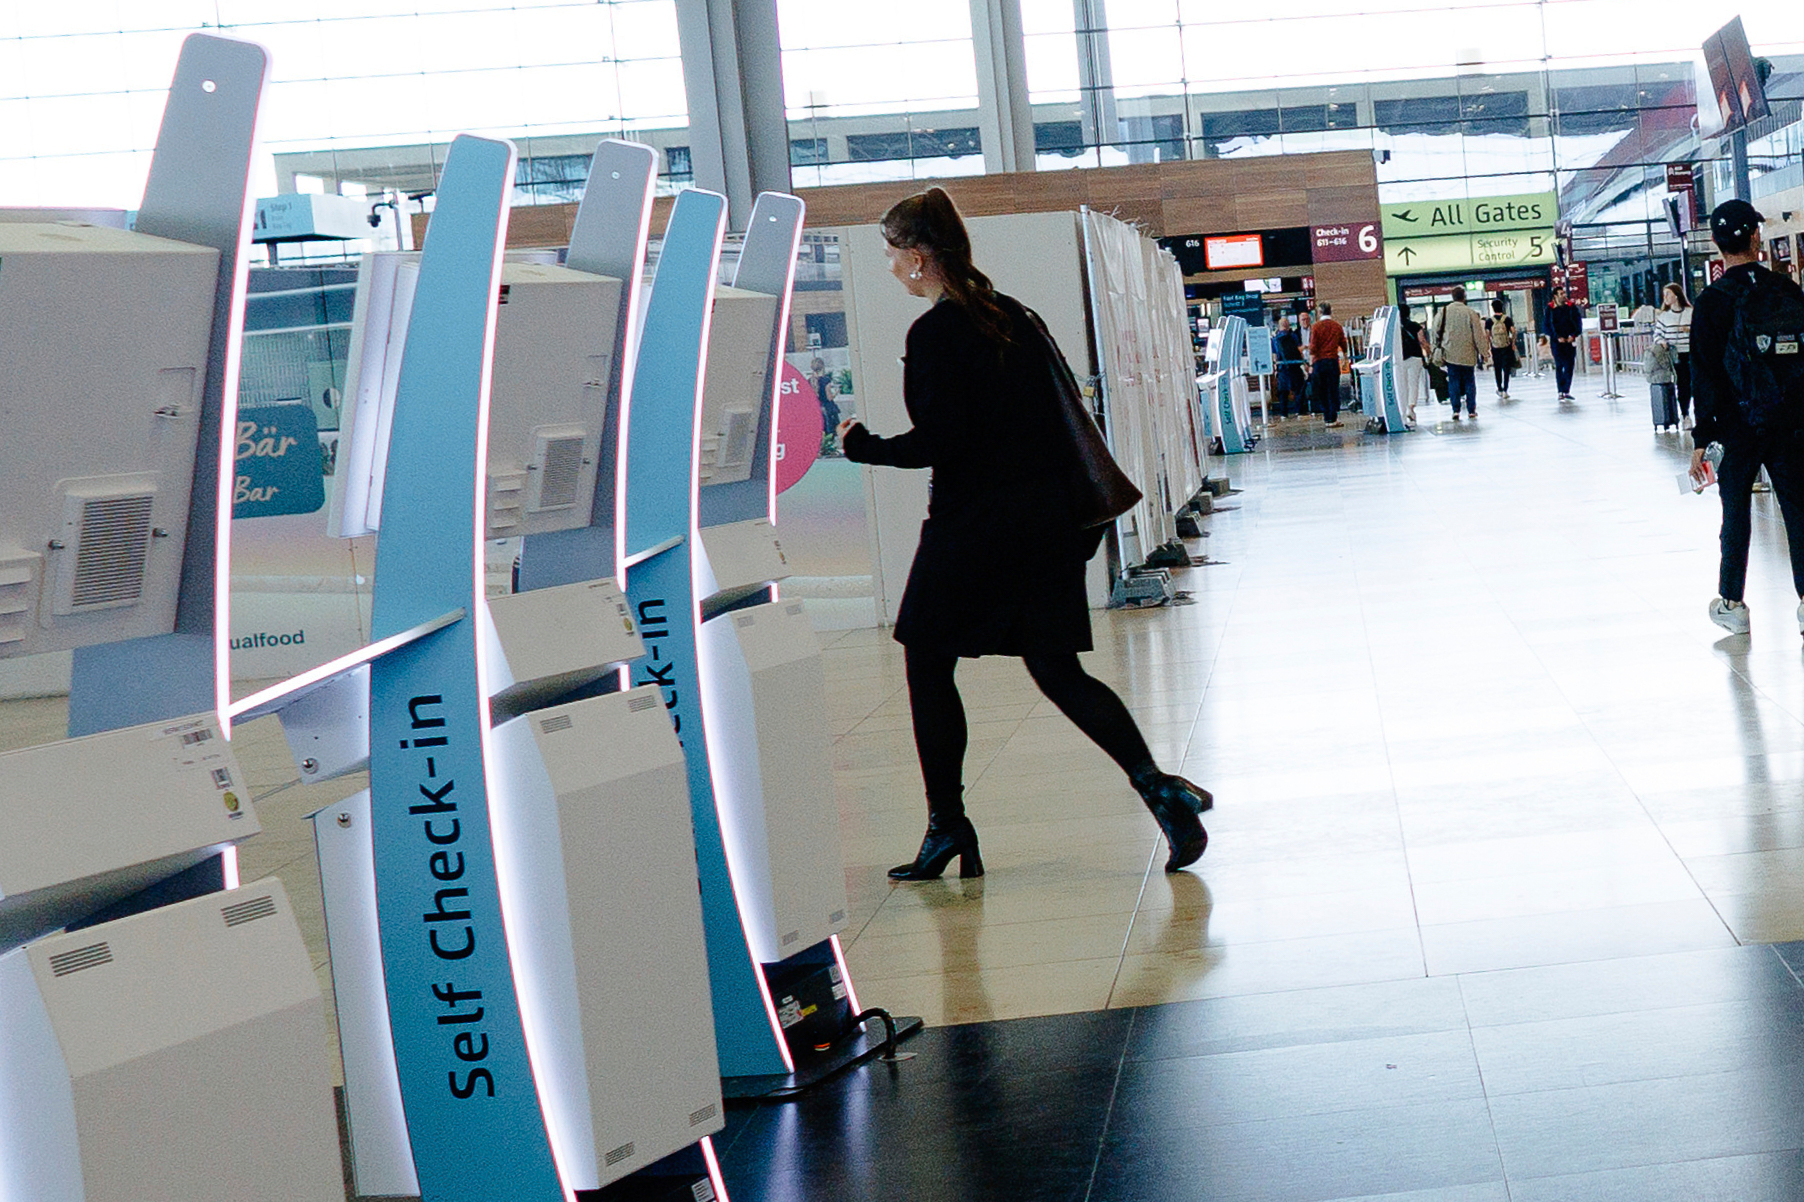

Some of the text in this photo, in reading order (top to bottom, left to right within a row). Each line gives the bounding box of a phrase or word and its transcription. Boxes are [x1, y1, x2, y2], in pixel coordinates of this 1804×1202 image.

[1431, 201, 1542, 226] All Gates
[1315, 225, 1378, 253] Check-in 6
[1477, 236, 1543, 258] Security 5
[1478, 250, 1516, 262] Control
[235, 421, 298, 460] Bär
[232, 475, 280, 504] Bar
[399, 695, 495, 1100] Self Check-in
